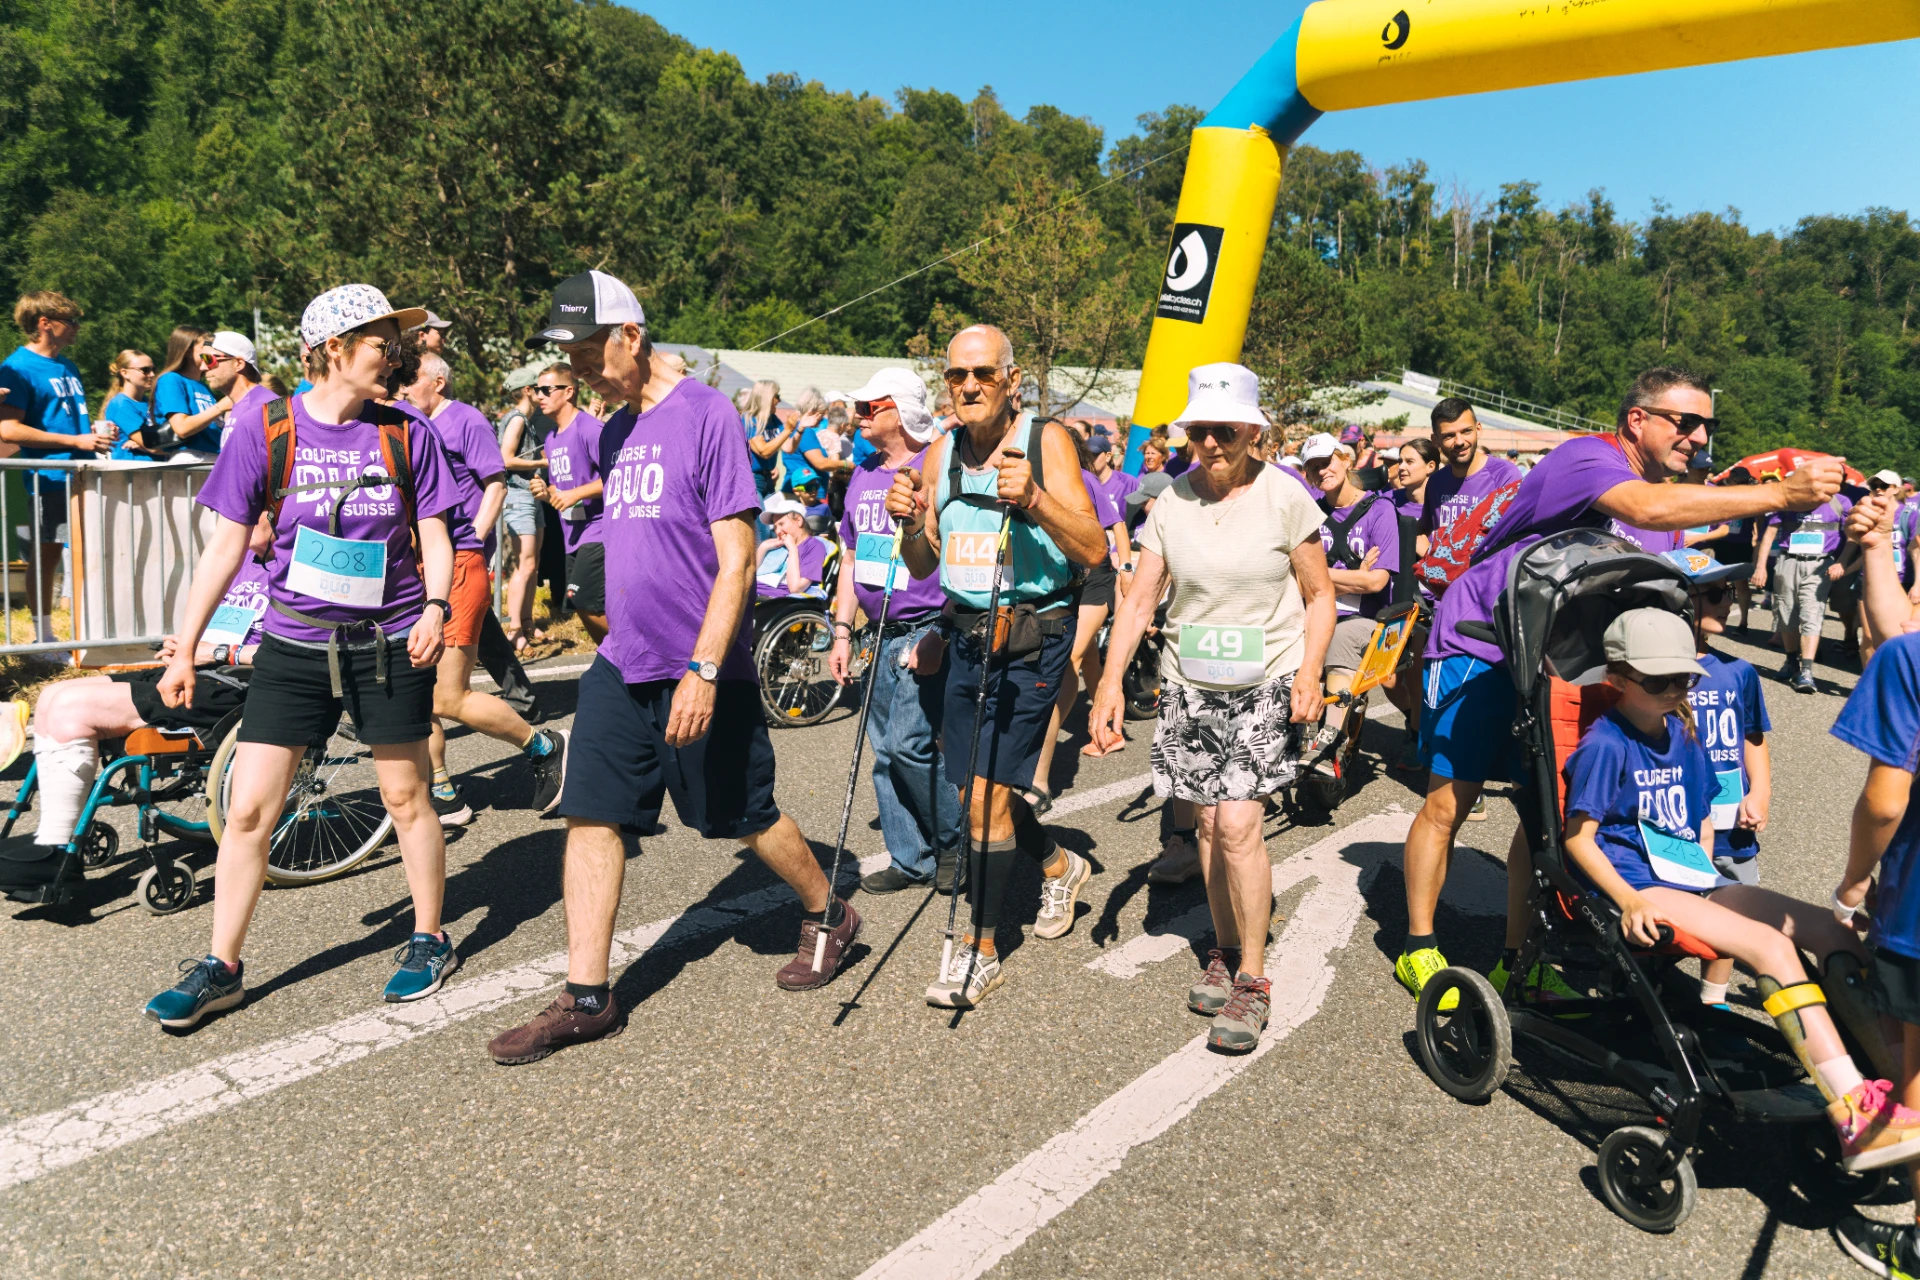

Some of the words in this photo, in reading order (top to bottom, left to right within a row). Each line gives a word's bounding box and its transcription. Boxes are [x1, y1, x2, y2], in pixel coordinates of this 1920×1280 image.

[560, 304, 588, 314] Thierry
[295, 447, 361, 465] COURSE
[550, 454, 571, 477] DUO
[611, 444, 648, 466] COURSE
[296, 464, 393, 504] DUO
[605, 462, 664, 507] DUO
[859, 488, 888, 501] COURS
[343, 502, 397, 517] SUISSE
[628, 504, 662, 519] SUISSE
[1440, 504, 1467, 528] DU
[311, 540, 367, 572] 208
[865, 538, 904, 563] 20
[955, 535, 998, 564] 144
[1320, 535, 1365, 560] DO
[320, 578, 351, 595] DUO
[964, 572, 987, 583] DUO
[1197, 629, 1243, 658] 49
[1207, 665, 1235, 678] DUO
[1686, 690, 1720, 706] RSE
[1693, 707, 1738, 748] UO
[1708, 748, 1739, 763] UISSE
